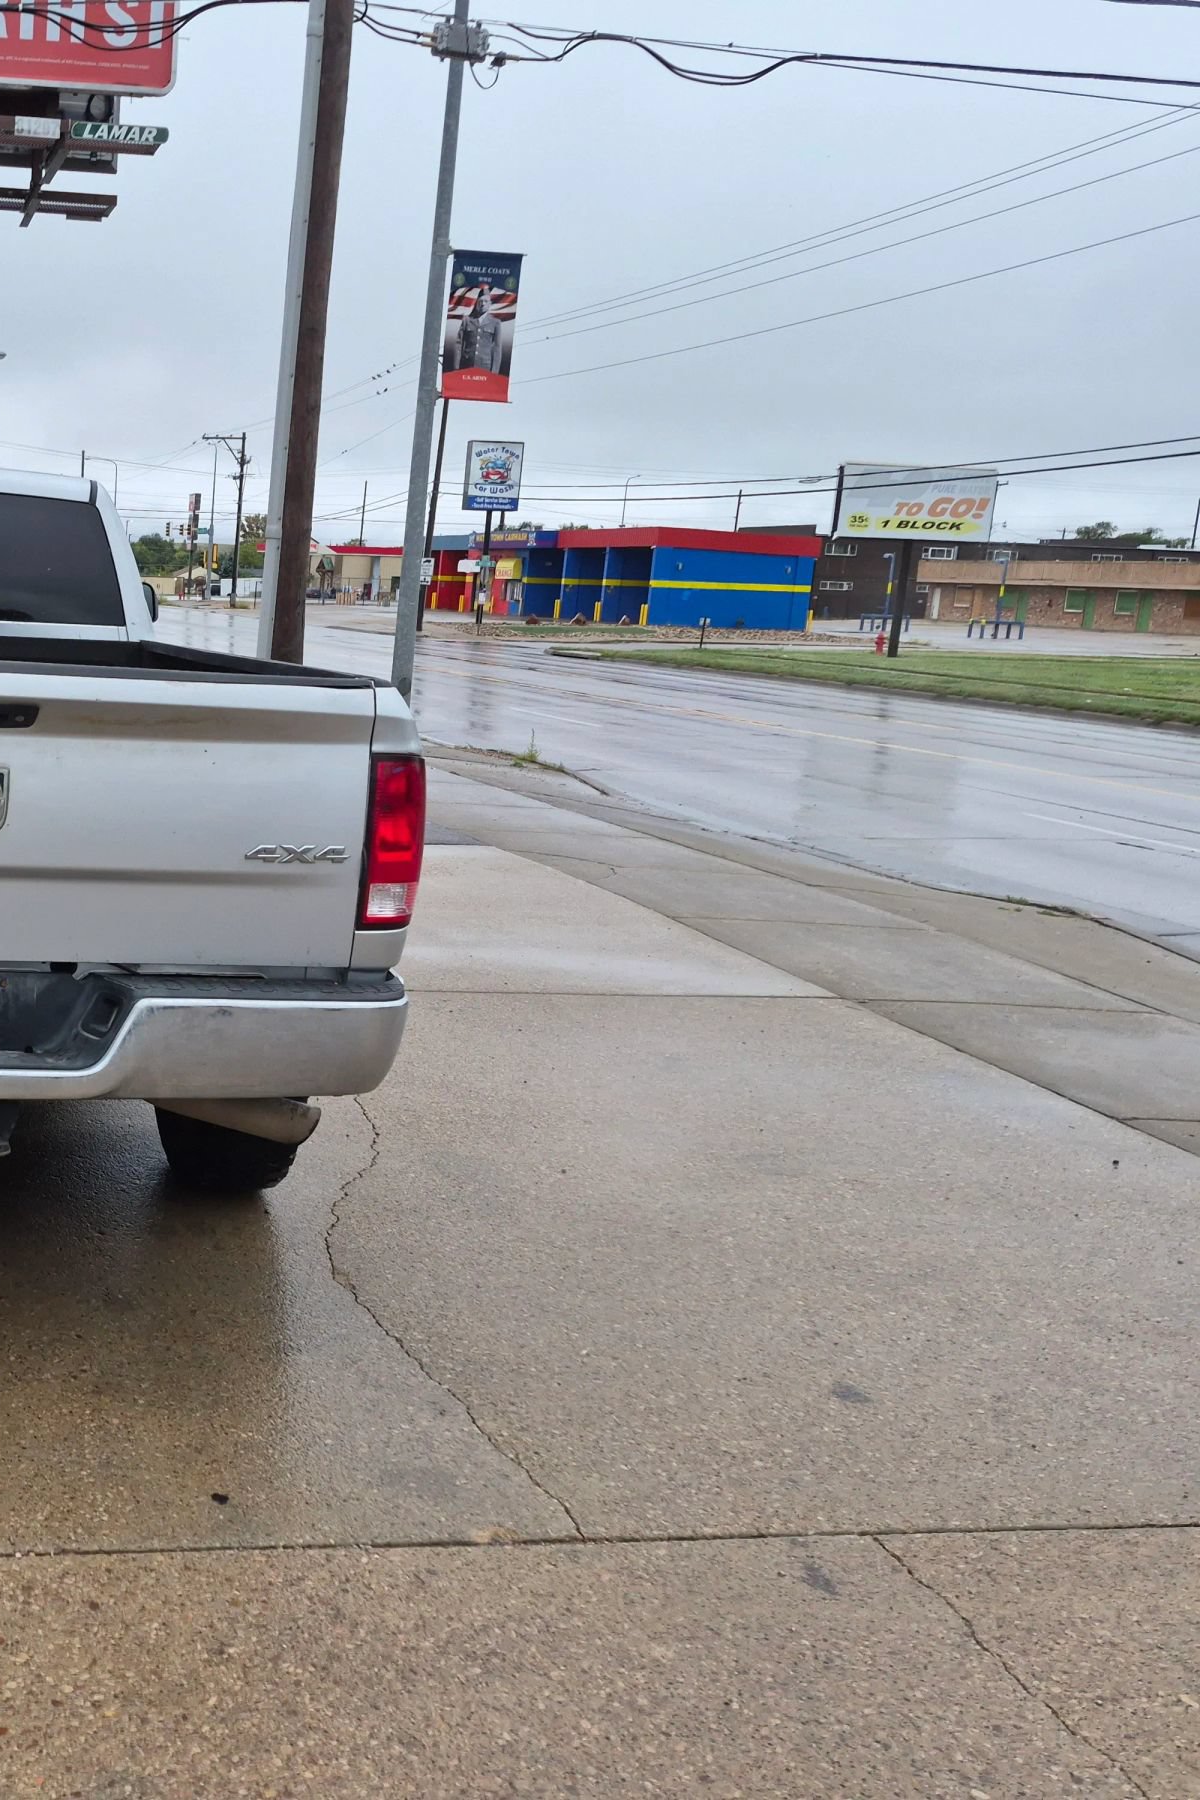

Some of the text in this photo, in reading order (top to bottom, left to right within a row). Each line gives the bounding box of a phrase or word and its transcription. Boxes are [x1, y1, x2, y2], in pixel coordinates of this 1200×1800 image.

[83, 122, 158, 142] LAMAR
[463, 265, 511, 275] MERLE COATS
[894, 496, 991, 519] TO GO!
[881, 519, 965, 531] 1 BLOCK
